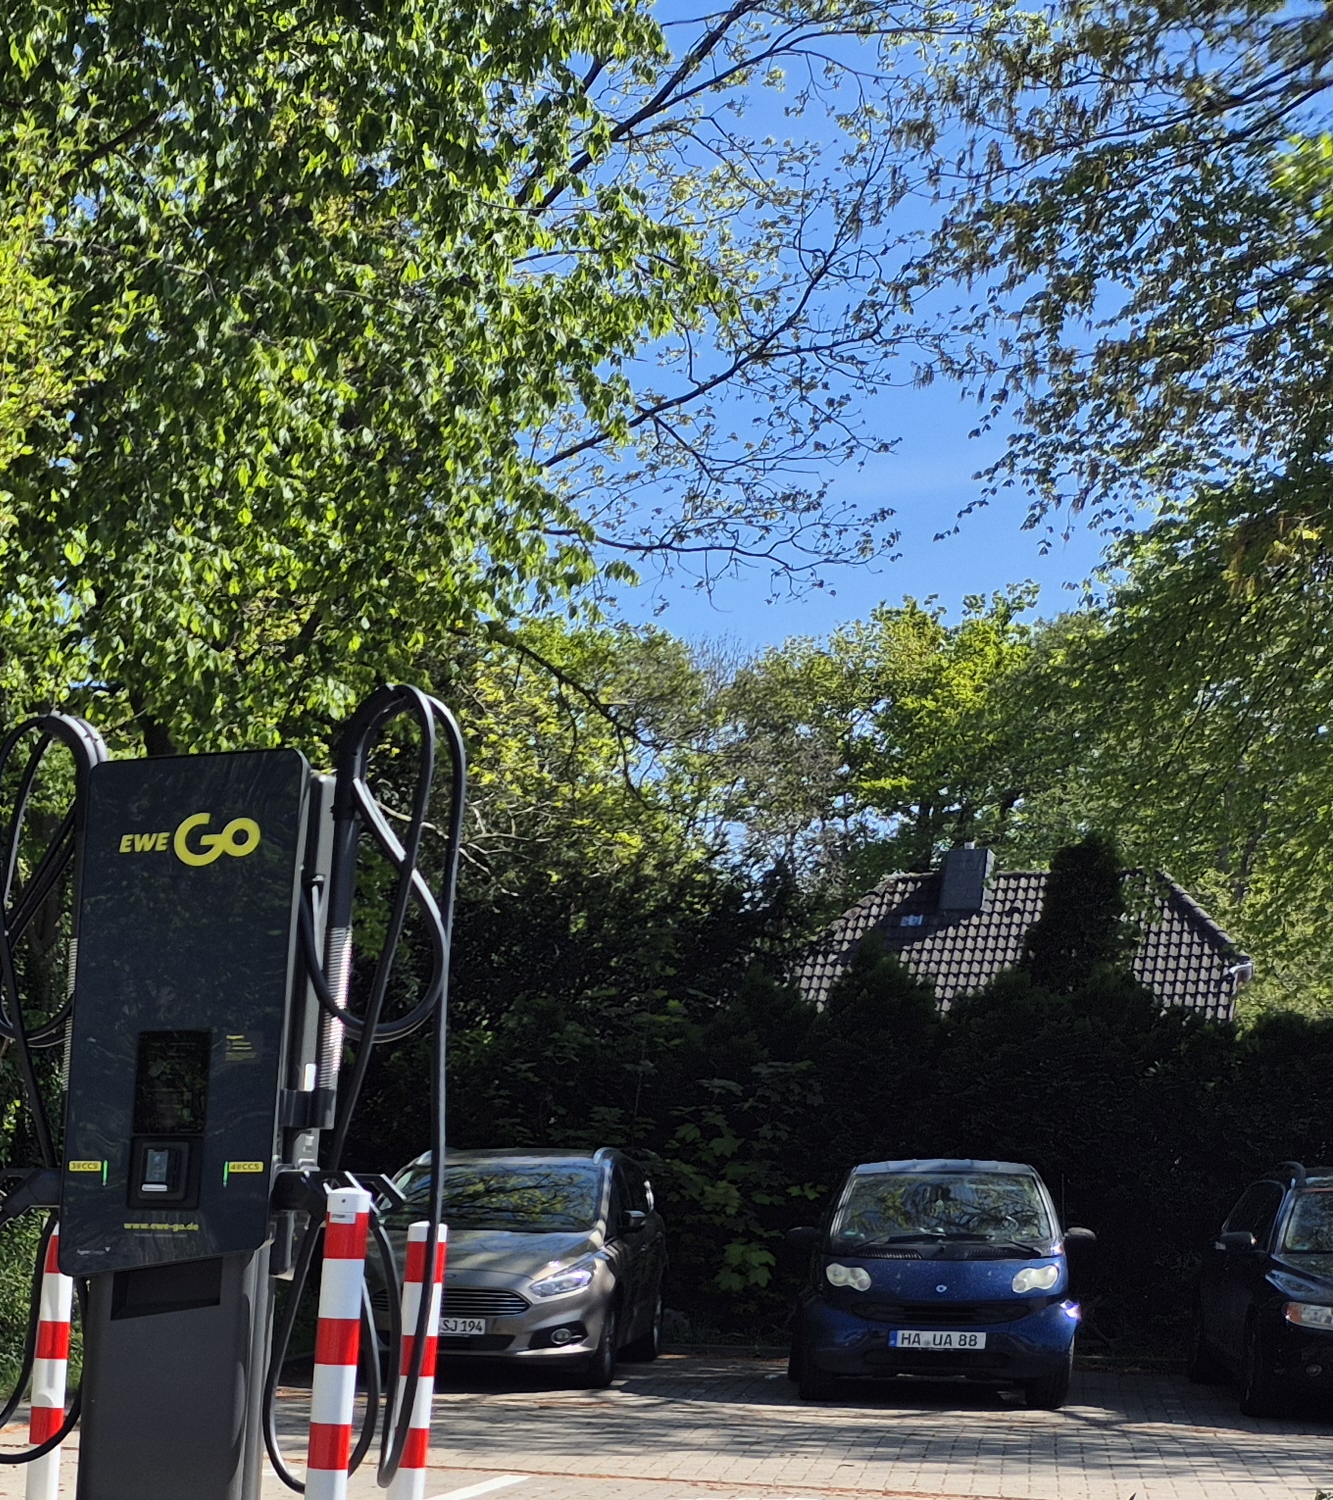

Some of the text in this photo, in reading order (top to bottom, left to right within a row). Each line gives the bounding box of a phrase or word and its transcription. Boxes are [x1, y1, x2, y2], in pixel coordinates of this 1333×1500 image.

[119, 832, 171, 854] EWE
[442, 1319, 483, 1333] SJ 194
[900, 1332, 978, 1347] HA UA 88
